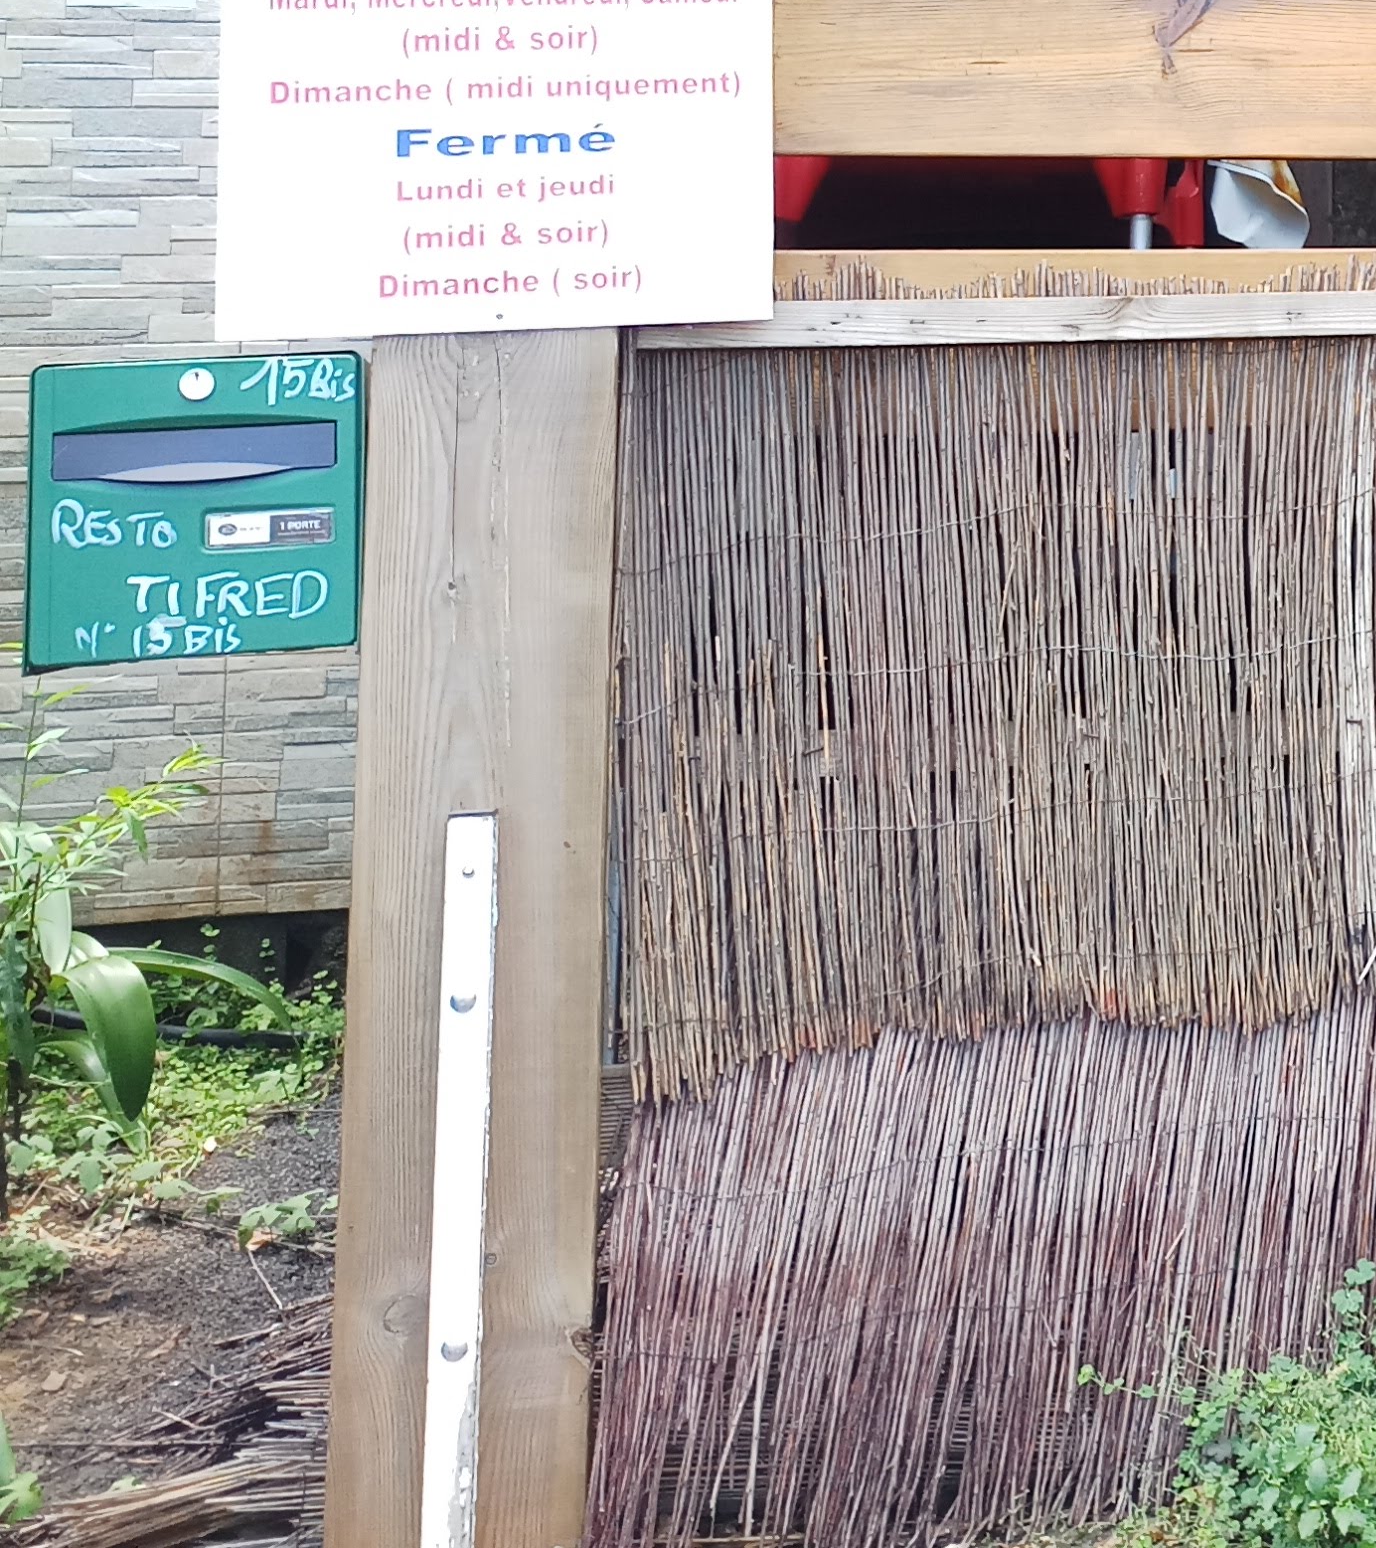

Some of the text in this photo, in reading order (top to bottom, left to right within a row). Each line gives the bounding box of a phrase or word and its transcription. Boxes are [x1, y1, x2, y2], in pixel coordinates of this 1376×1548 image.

[402, 24, 598, 59] (midi & soir)
[270, 78, 432, 104] Dimanche
[546, 71, 740, 102] uniquement)
[396, 122, 616, 159] Fermé
[397, 174, 614, 203] Lundi et jeudi
[403, 219, 608, 255] (midi & soir)
[379, 269, 539, 299] Dimanche
[574, 264, 641, 293] soir)
[51, 498, 177, 549] RESTO
[127, 570, 328, 619] TI FRED
